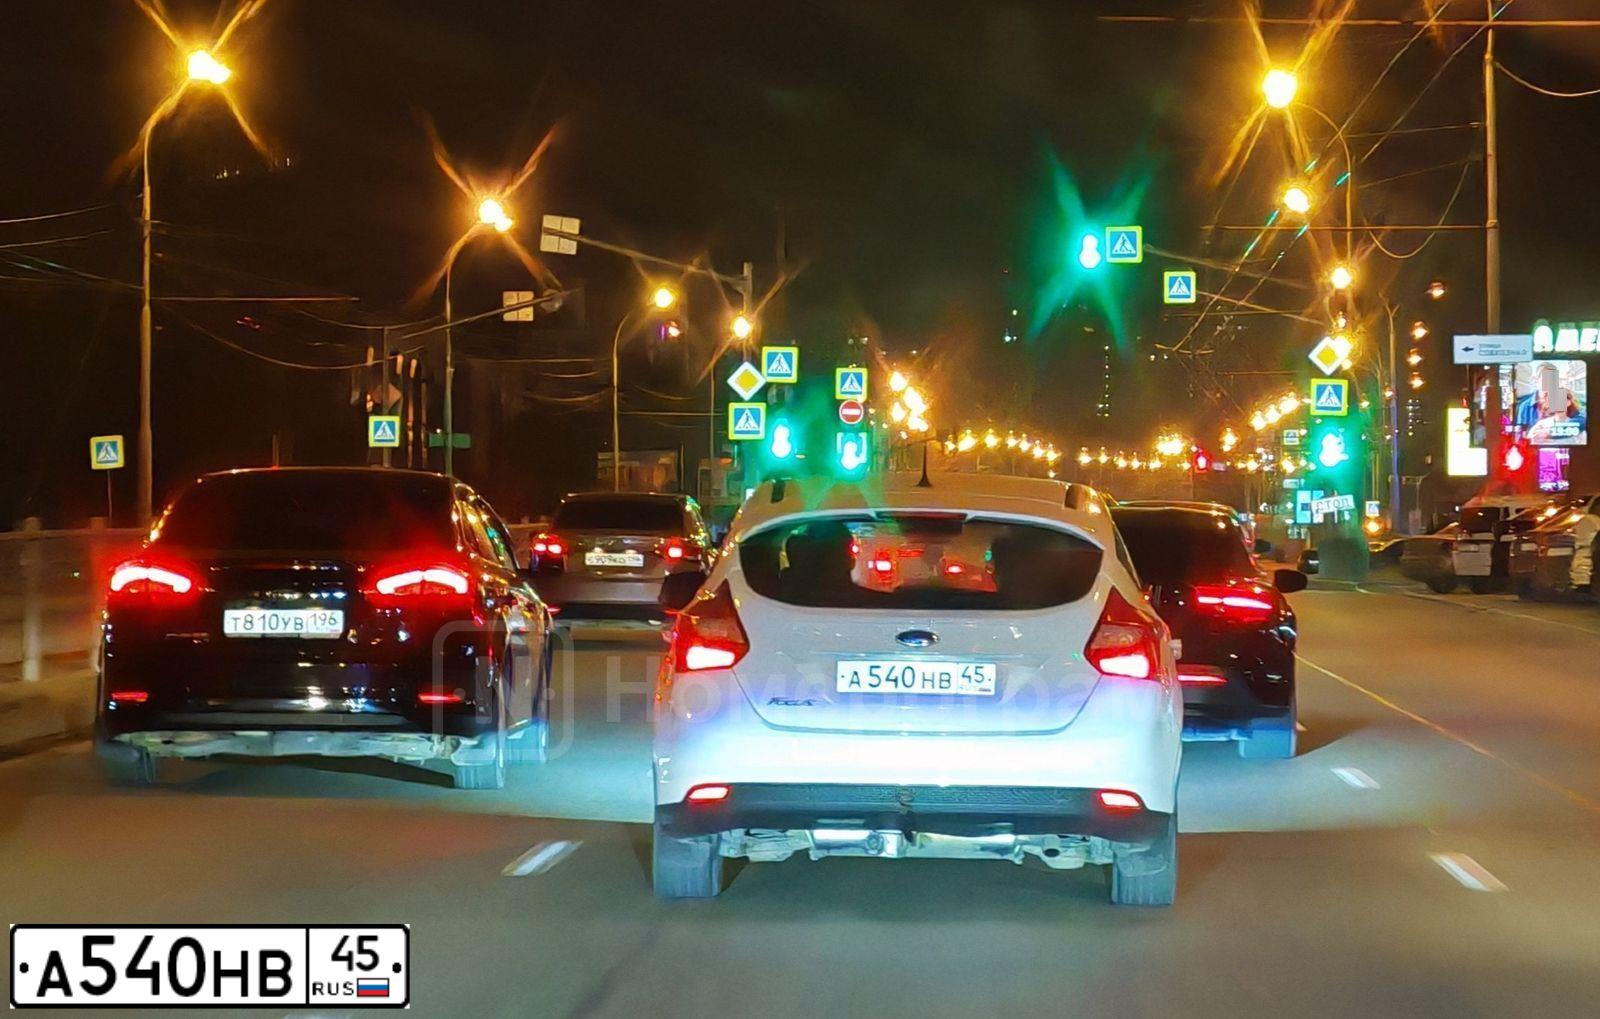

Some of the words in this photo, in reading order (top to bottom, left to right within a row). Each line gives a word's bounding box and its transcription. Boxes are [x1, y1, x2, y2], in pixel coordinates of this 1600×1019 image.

[231, 613, 304, 631] Т810УВ
[311, 612, 338, 626] 196
[848, 665, 952, 690] А540НВ
[961, 665, 985, 684] 45
